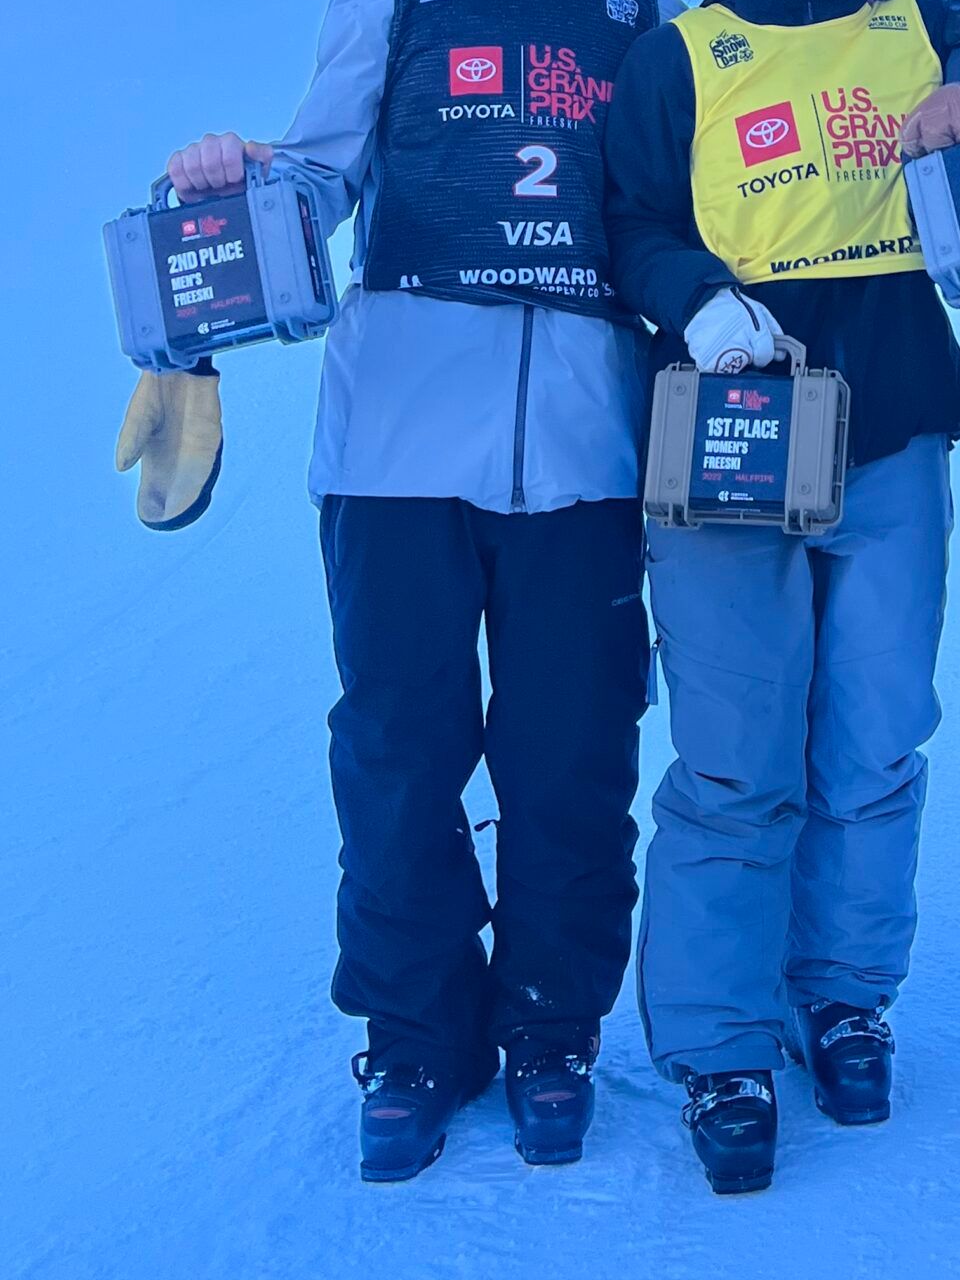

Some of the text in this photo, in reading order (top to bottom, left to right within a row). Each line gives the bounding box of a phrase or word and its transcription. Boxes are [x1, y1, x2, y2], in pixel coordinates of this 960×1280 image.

[528, 44, 582, 73] U.S.
[529, 90, 596, 124] PRIX
[820, 86, 878, 114] U.S.
[438, 104, 515, 122] TOYOTA
[529, 116, 578, 130] FREESKI
[826, 113, 908, 141] GRAN
[512, 144, 558, 197] 2
[737, 162, 821, 199] TOYOTA
[836, 168, 887, 183] FREESKI
[496, 220, 574, 247] VISA
[167, 239, 245, 274] 2ND PLACE
[170, 272, 203, 291] MEN'S
[458, 266, 598, 286] WOODWARD
[173, 286, 215, 308] FREESKI
[706, 417, 779, 440] 1ST PLACE
[704, 439, 749, 455] WOMEN'S
[702, 455, 742, 471] FREESKI
